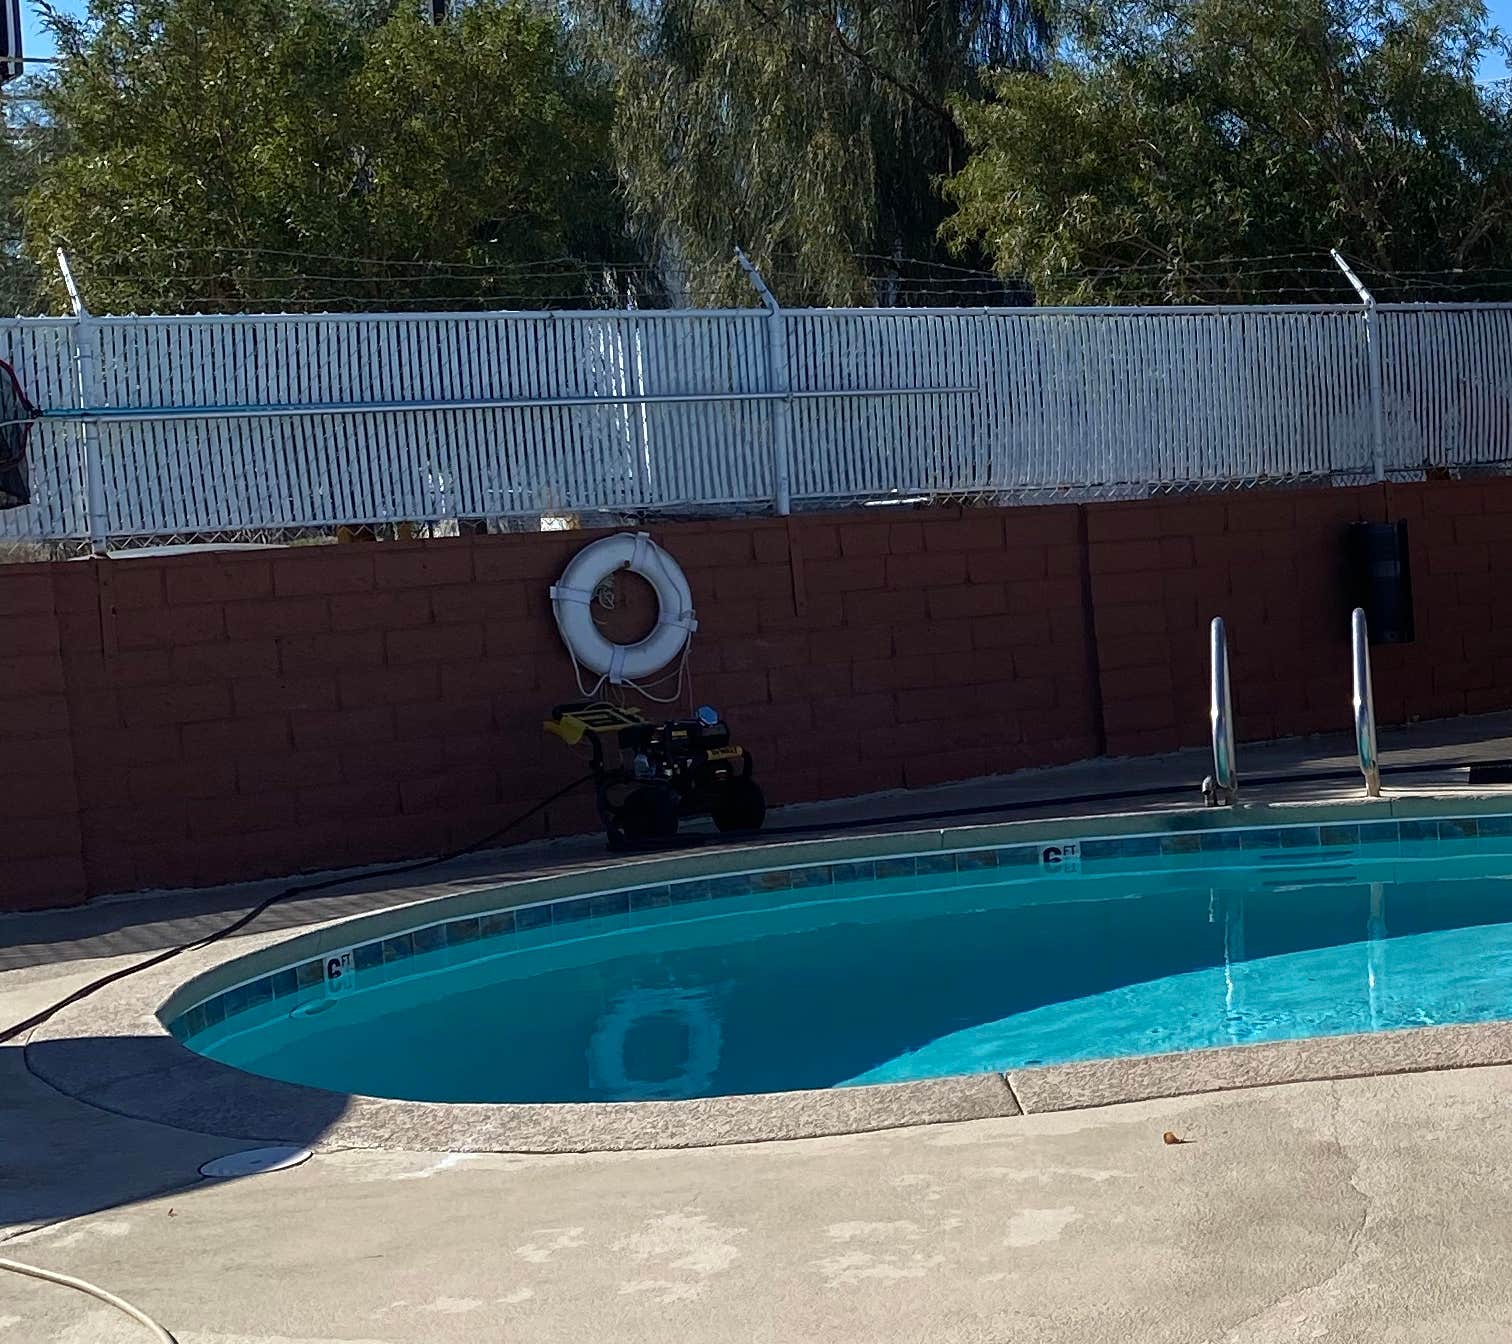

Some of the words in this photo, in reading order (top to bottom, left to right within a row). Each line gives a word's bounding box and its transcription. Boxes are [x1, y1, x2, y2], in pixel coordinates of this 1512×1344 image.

[1063, 845, 1076, 856] FT
[328, 958, 341, 979] 6
[342, 953, 350, 966] FT
